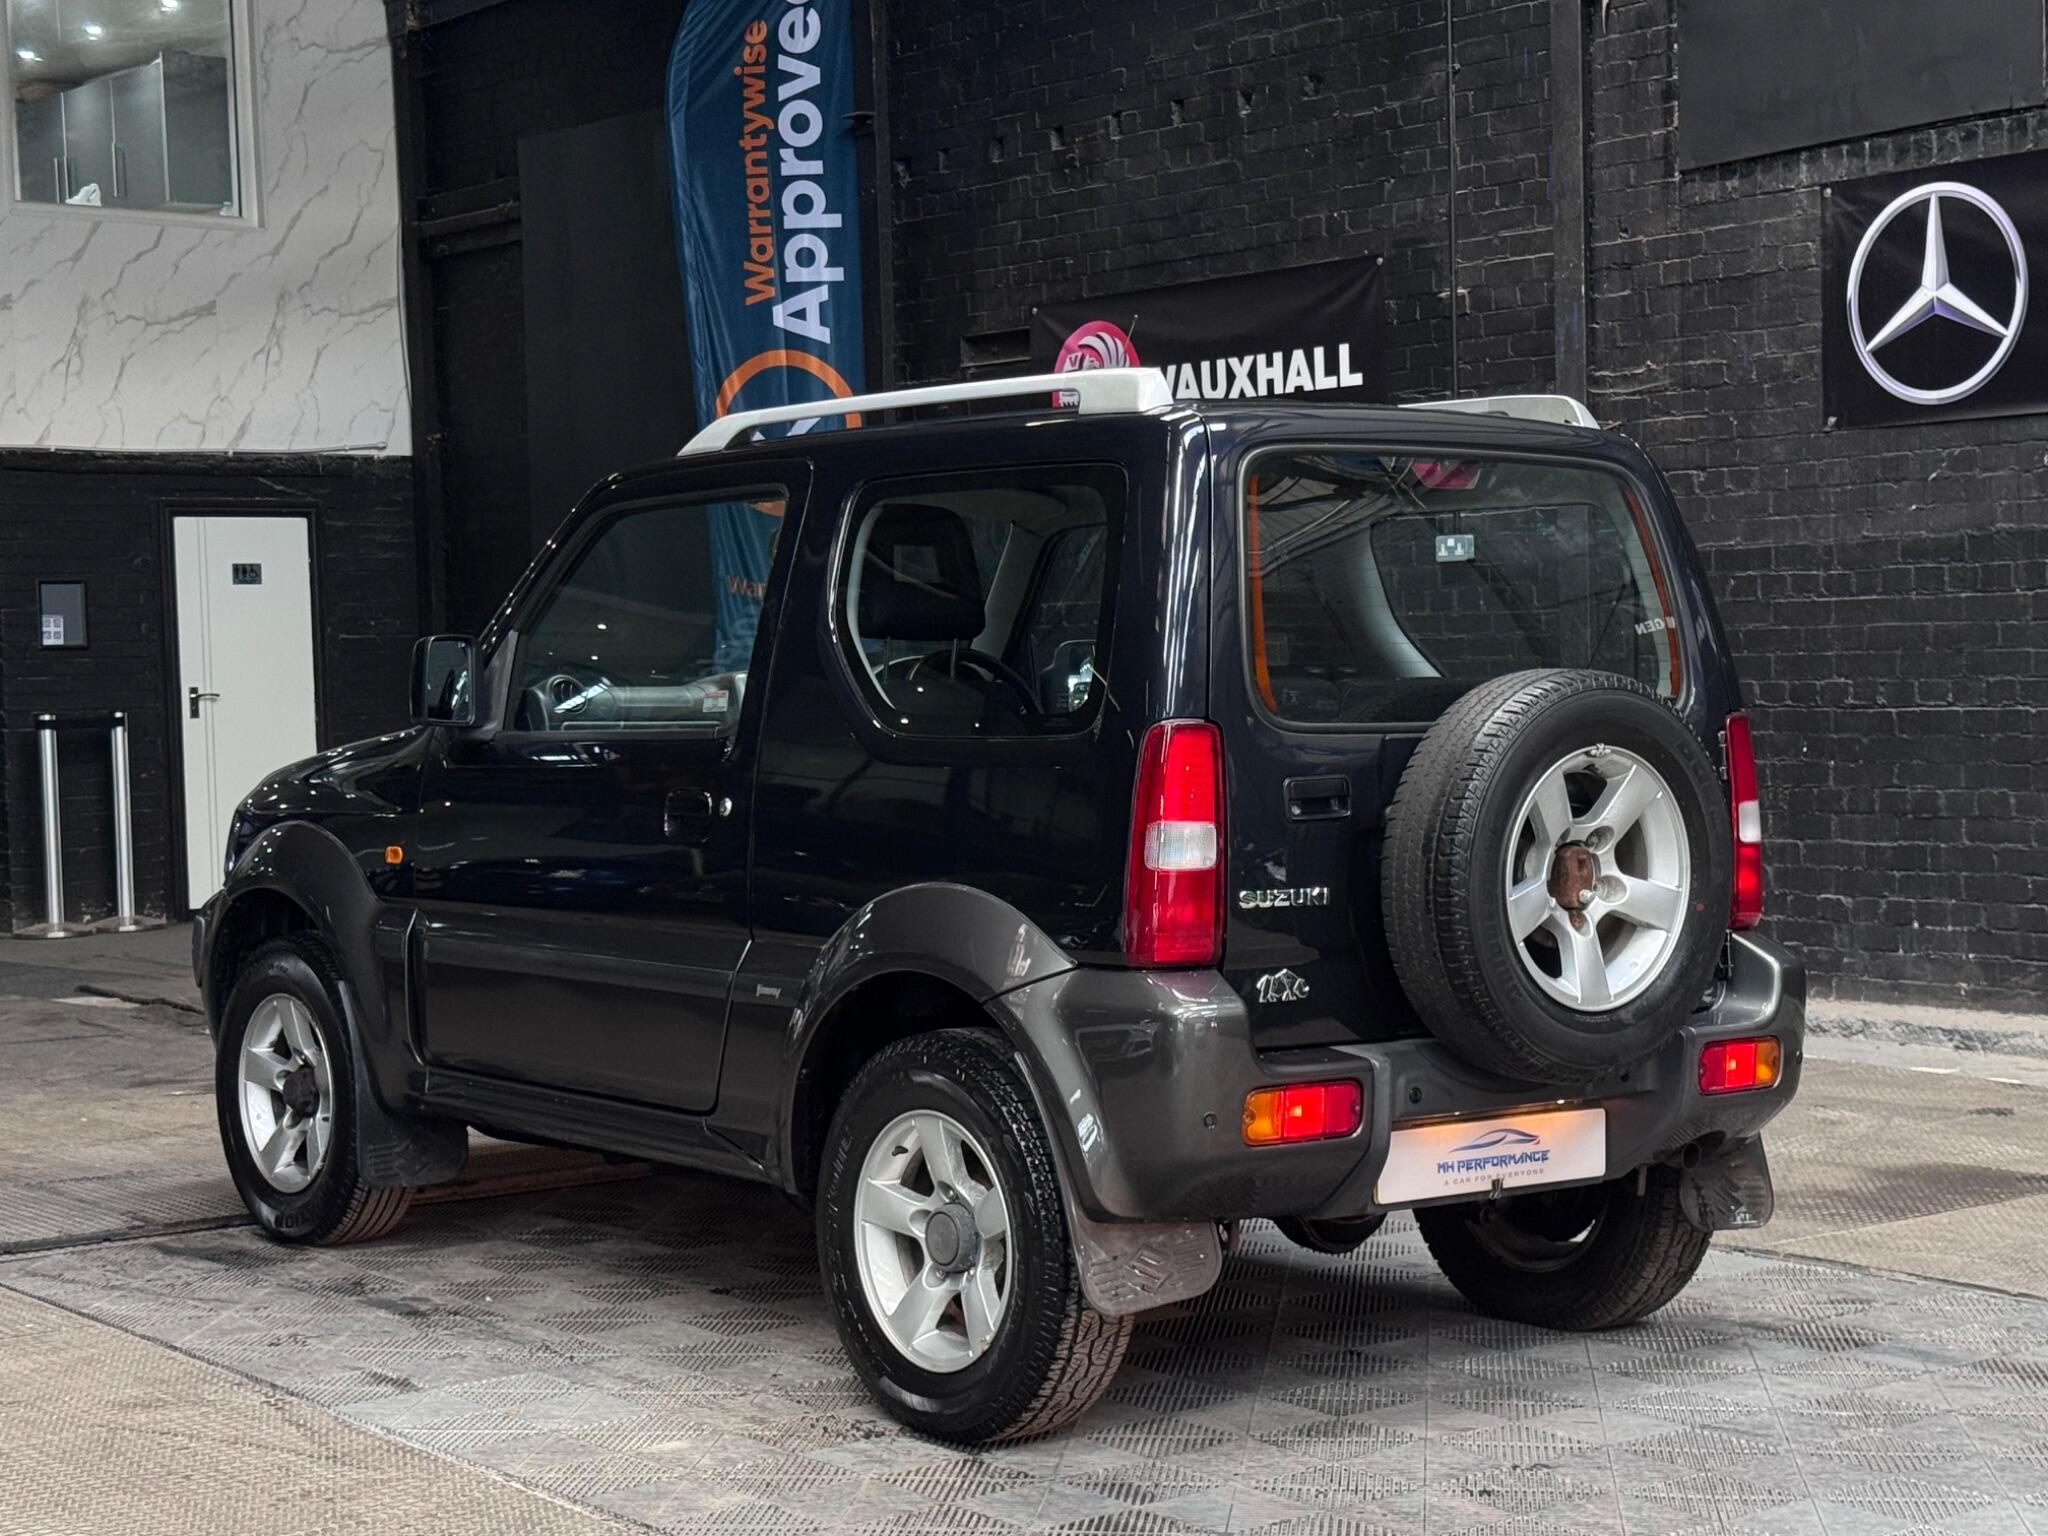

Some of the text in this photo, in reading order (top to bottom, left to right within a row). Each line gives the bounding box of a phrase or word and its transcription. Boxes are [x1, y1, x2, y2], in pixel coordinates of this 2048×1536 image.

[733, 18, 777, 306] Warrantywise
[772, 0, 845, 344] Approve
[1238, 886, 1329, 909] SUZUKI
[1457, 1150, 1550, 1172] PERFORMANCE
[1453, 1177, 1471, 1185] CAR
